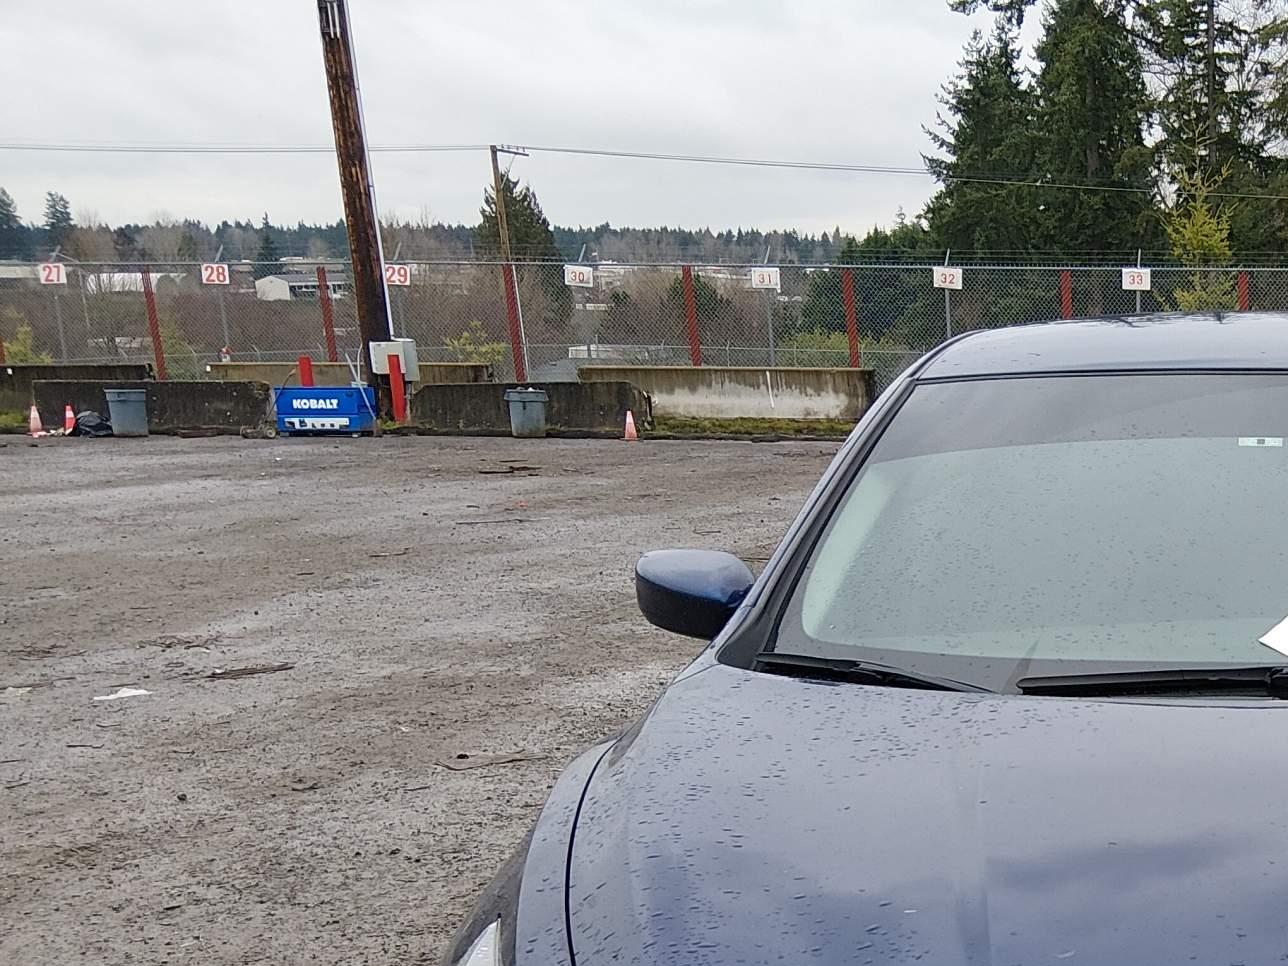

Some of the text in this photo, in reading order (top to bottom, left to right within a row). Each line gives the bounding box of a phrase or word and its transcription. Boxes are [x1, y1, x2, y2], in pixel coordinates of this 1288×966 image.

[42, 264, 62, 283] 27
[205, 265, 228, 283] 28
[387, 266, 408, 284] 29
[570, 271, 585, 282] 30
[757, 272, 772, 284] 31
[940, 272, 956, 284] 32
[1128, 273, 1144, 285] 33
[292, 398, 338, 409] KOBALT
